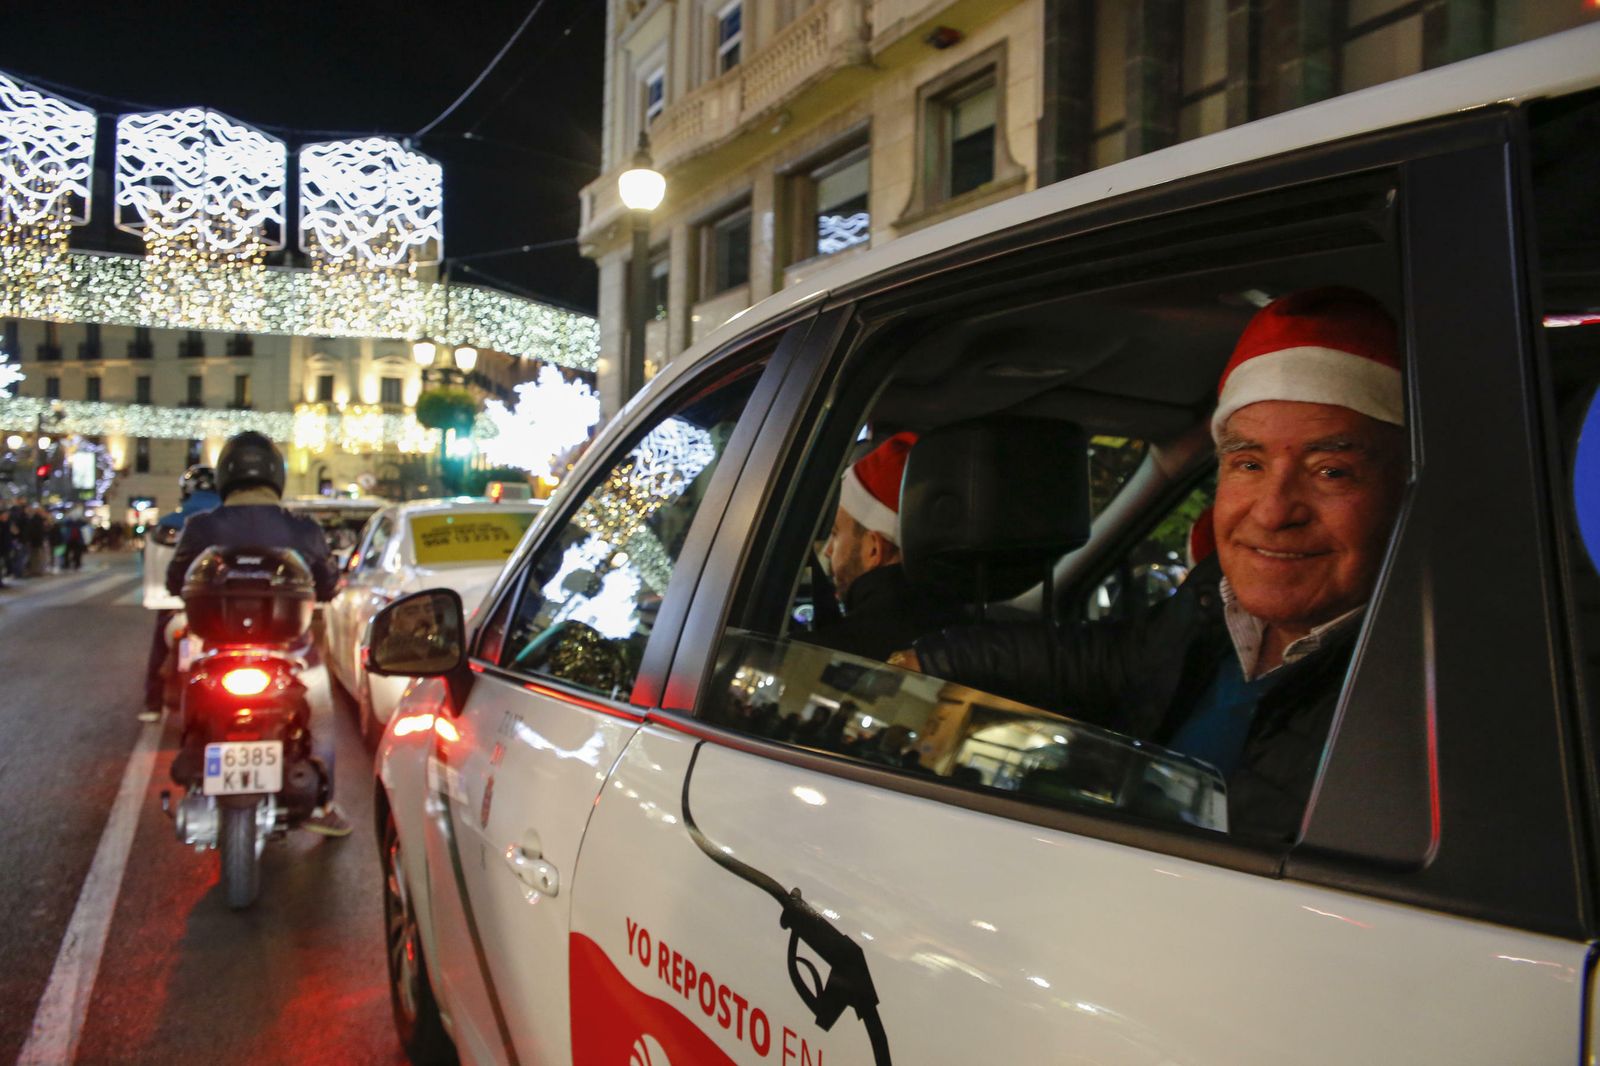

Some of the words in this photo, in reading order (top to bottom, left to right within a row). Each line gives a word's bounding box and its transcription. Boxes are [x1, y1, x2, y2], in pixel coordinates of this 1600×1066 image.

[223, 747, 277, 767] 6385
[626, 917, 651, 967] YO
[658, 940, 770, 1057] REPOSTO
